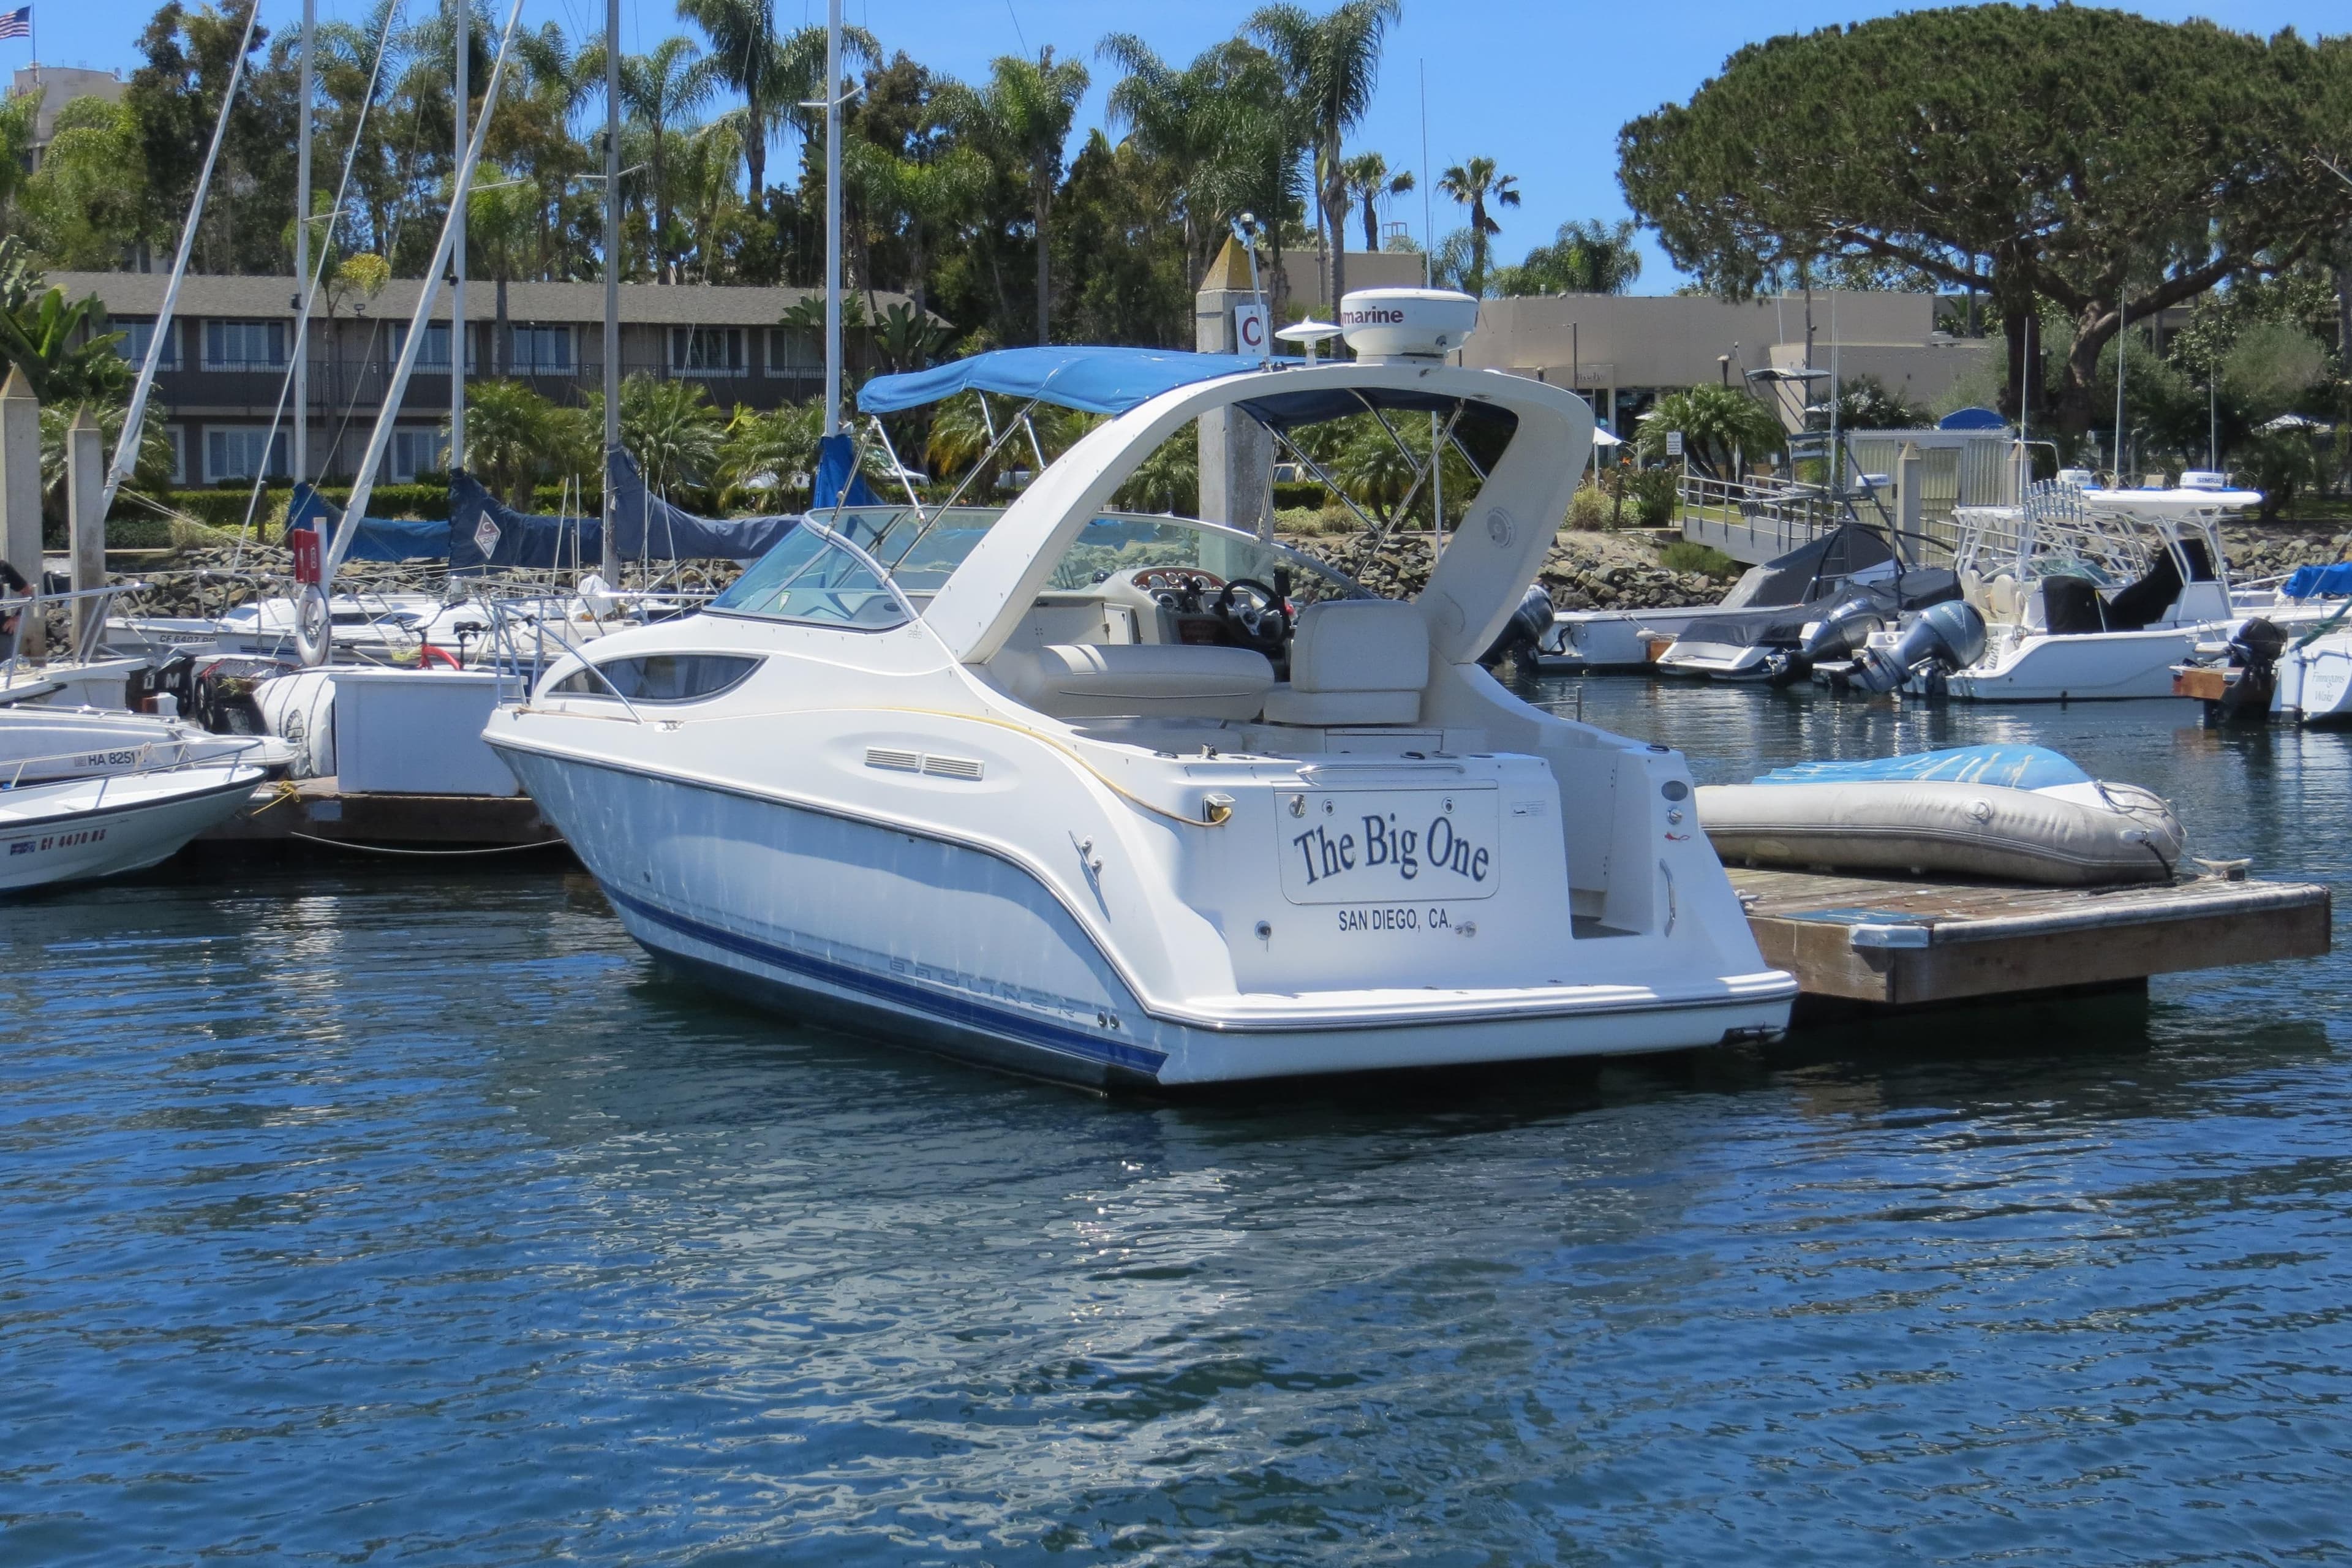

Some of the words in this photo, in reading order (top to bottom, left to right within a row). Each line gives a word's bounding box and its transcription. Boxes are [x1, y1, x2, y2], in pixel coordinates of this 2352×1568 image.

[1242, 317, 1262, 346] C
[482, 521, 491, 532] C
[2312, 671, 2345, 688] Finnegans
[88, 754, 106, 766] HA
[109, 751, 135, 764] 8251
[40, 837, 53, 851] CF
[1294, 824, 1356, 885] The
[1362, 813, 1417, 880] Big
[1428, 816, 1489, 882] One
[1339, 910, 1368, 931] SAN
[1373, 908, 1420, 933] DIEGO,
[1429, 908, 1452, 929] CA.
[889, 959, 1076, 1018] BAYLINER
